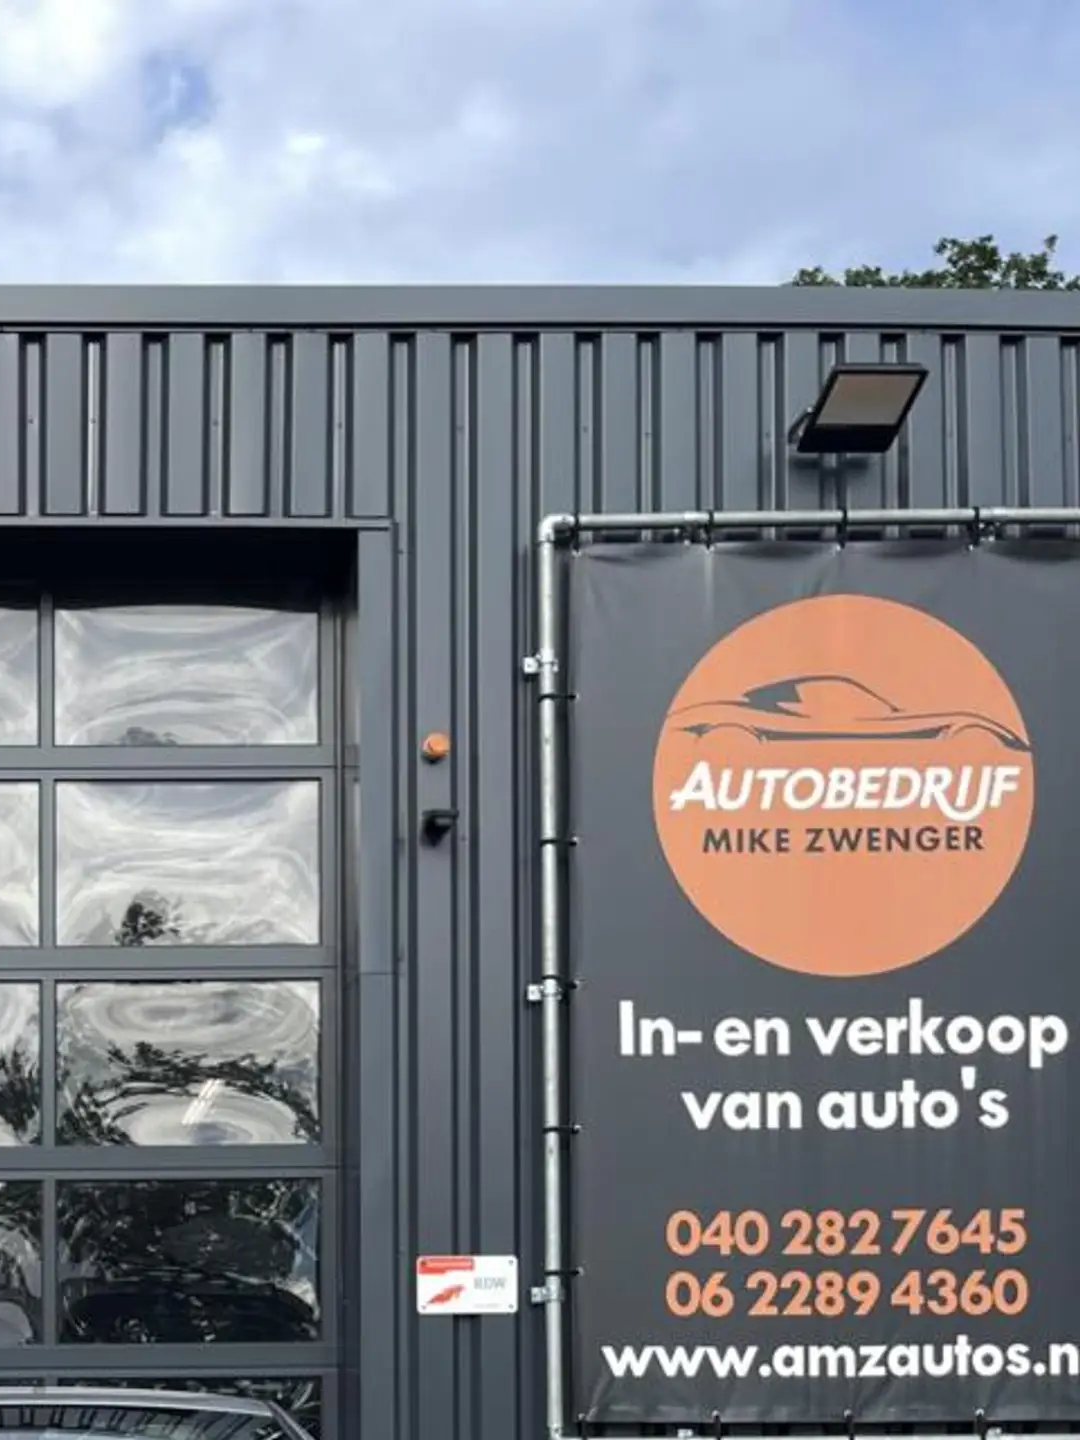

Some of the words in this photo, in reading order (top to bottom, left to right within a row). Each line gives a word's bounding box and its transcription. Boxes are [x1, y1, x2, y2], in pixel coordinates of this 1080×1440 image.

[670, 761, 1020, 821] AUTOBEDRIJF
[702, 828, 790, 853] MIKE
[805, 826, 983, 852] ZWENGER
[714, 1018, 789, 1056] en
[806, 998, 1068, 1068] verkoop
[682, 1092, 801, 1129] van
[818, 1067, 1008, 1129] auto's
[666, 1211, 769, 1255] 040
[782, 1209, 880, 1255] 282
[892, 1207, 1028, 1255] 7645
[666, 1270, 733, 1317] 06
[747, 1268, 880, 1316] 2289
[890, 1269, 1029, 1315] 4360
